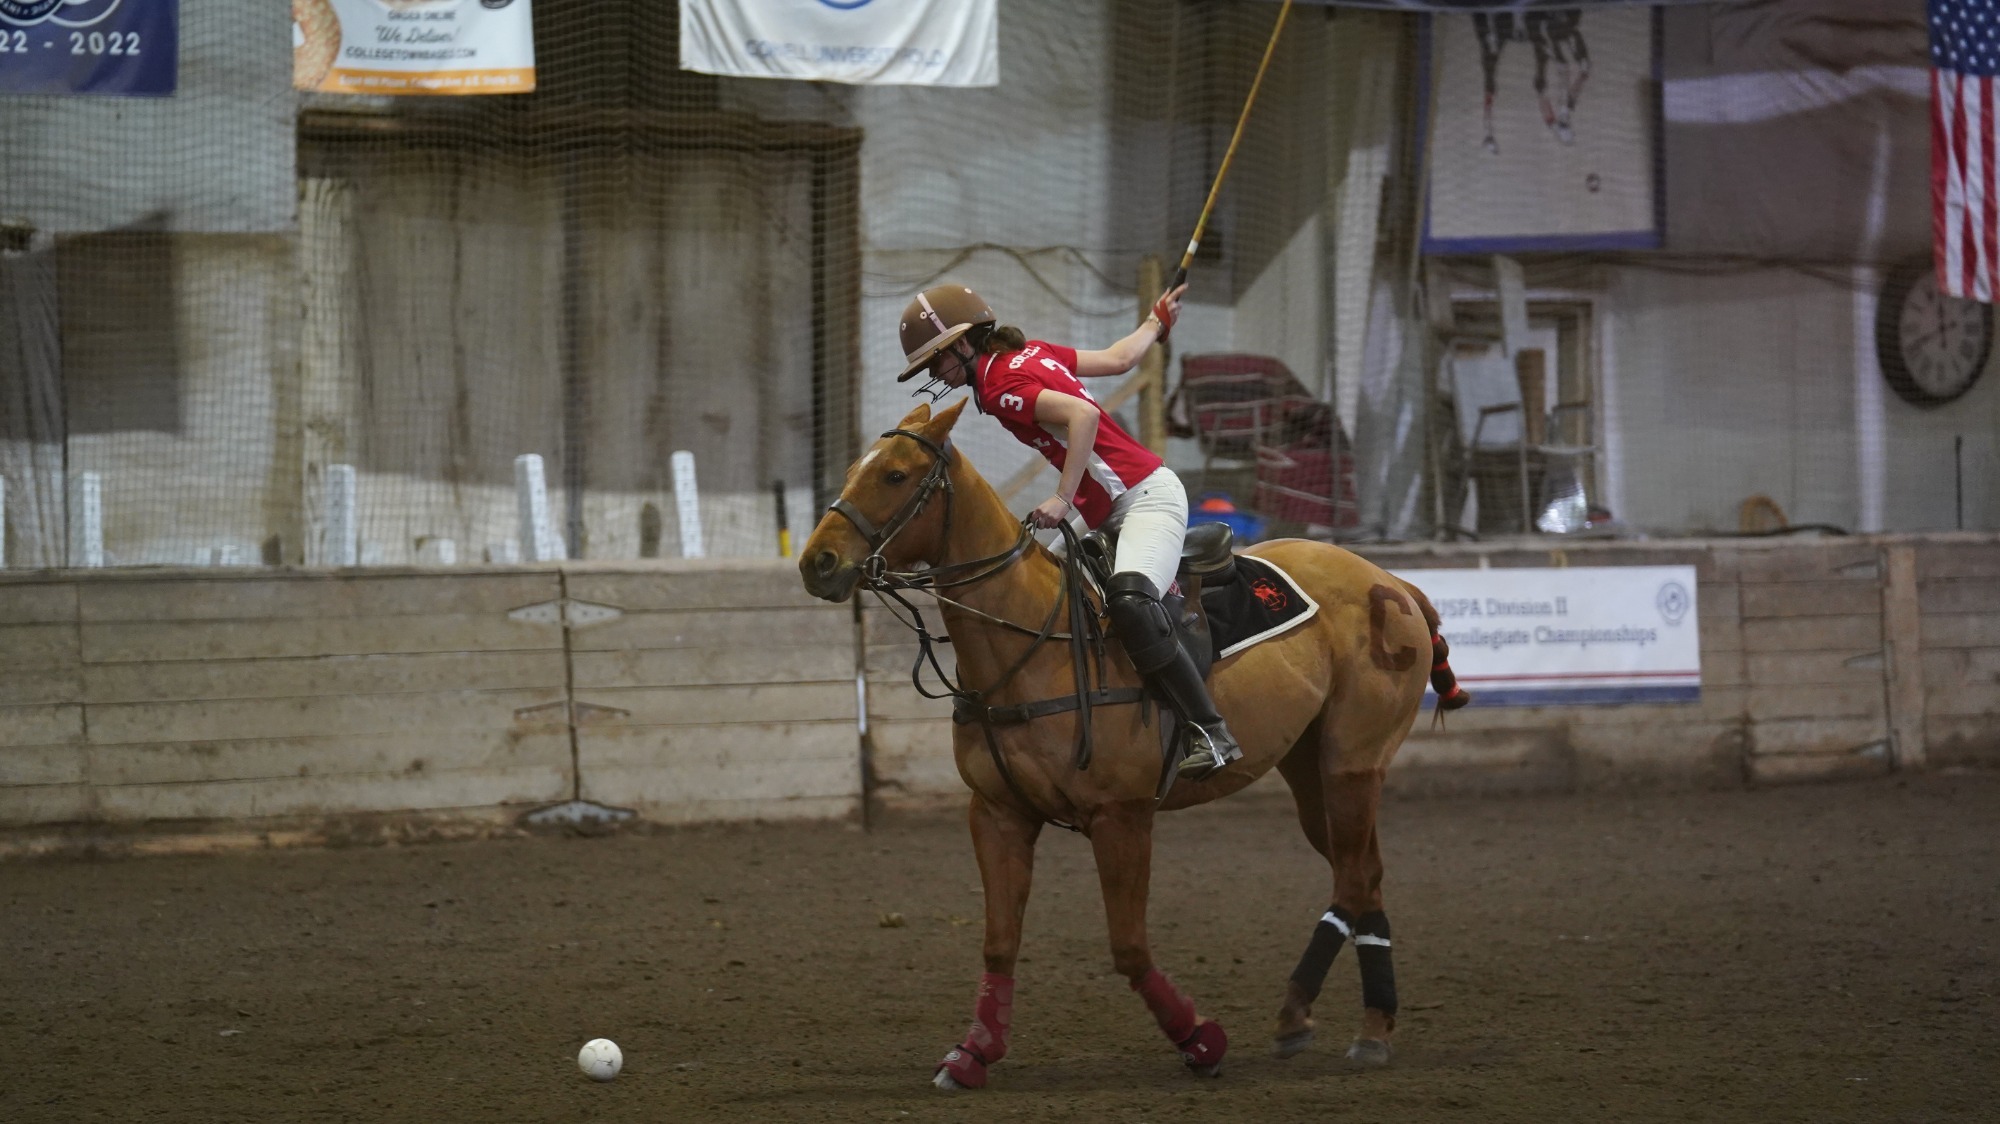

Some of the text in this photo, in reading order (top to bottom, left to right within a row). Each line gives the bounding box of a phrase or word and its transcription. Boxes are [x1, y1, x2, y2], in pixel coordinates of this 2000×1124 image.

[69, 31, 141, 55] 2022
[375, 25, 401, 43] We
[746, 39, 808, 62] COELL
[1000, 393, 1024, 412] 3
[1486, 597, 1552, 616] Division
[1534, 624, 1657, 649] Championships
